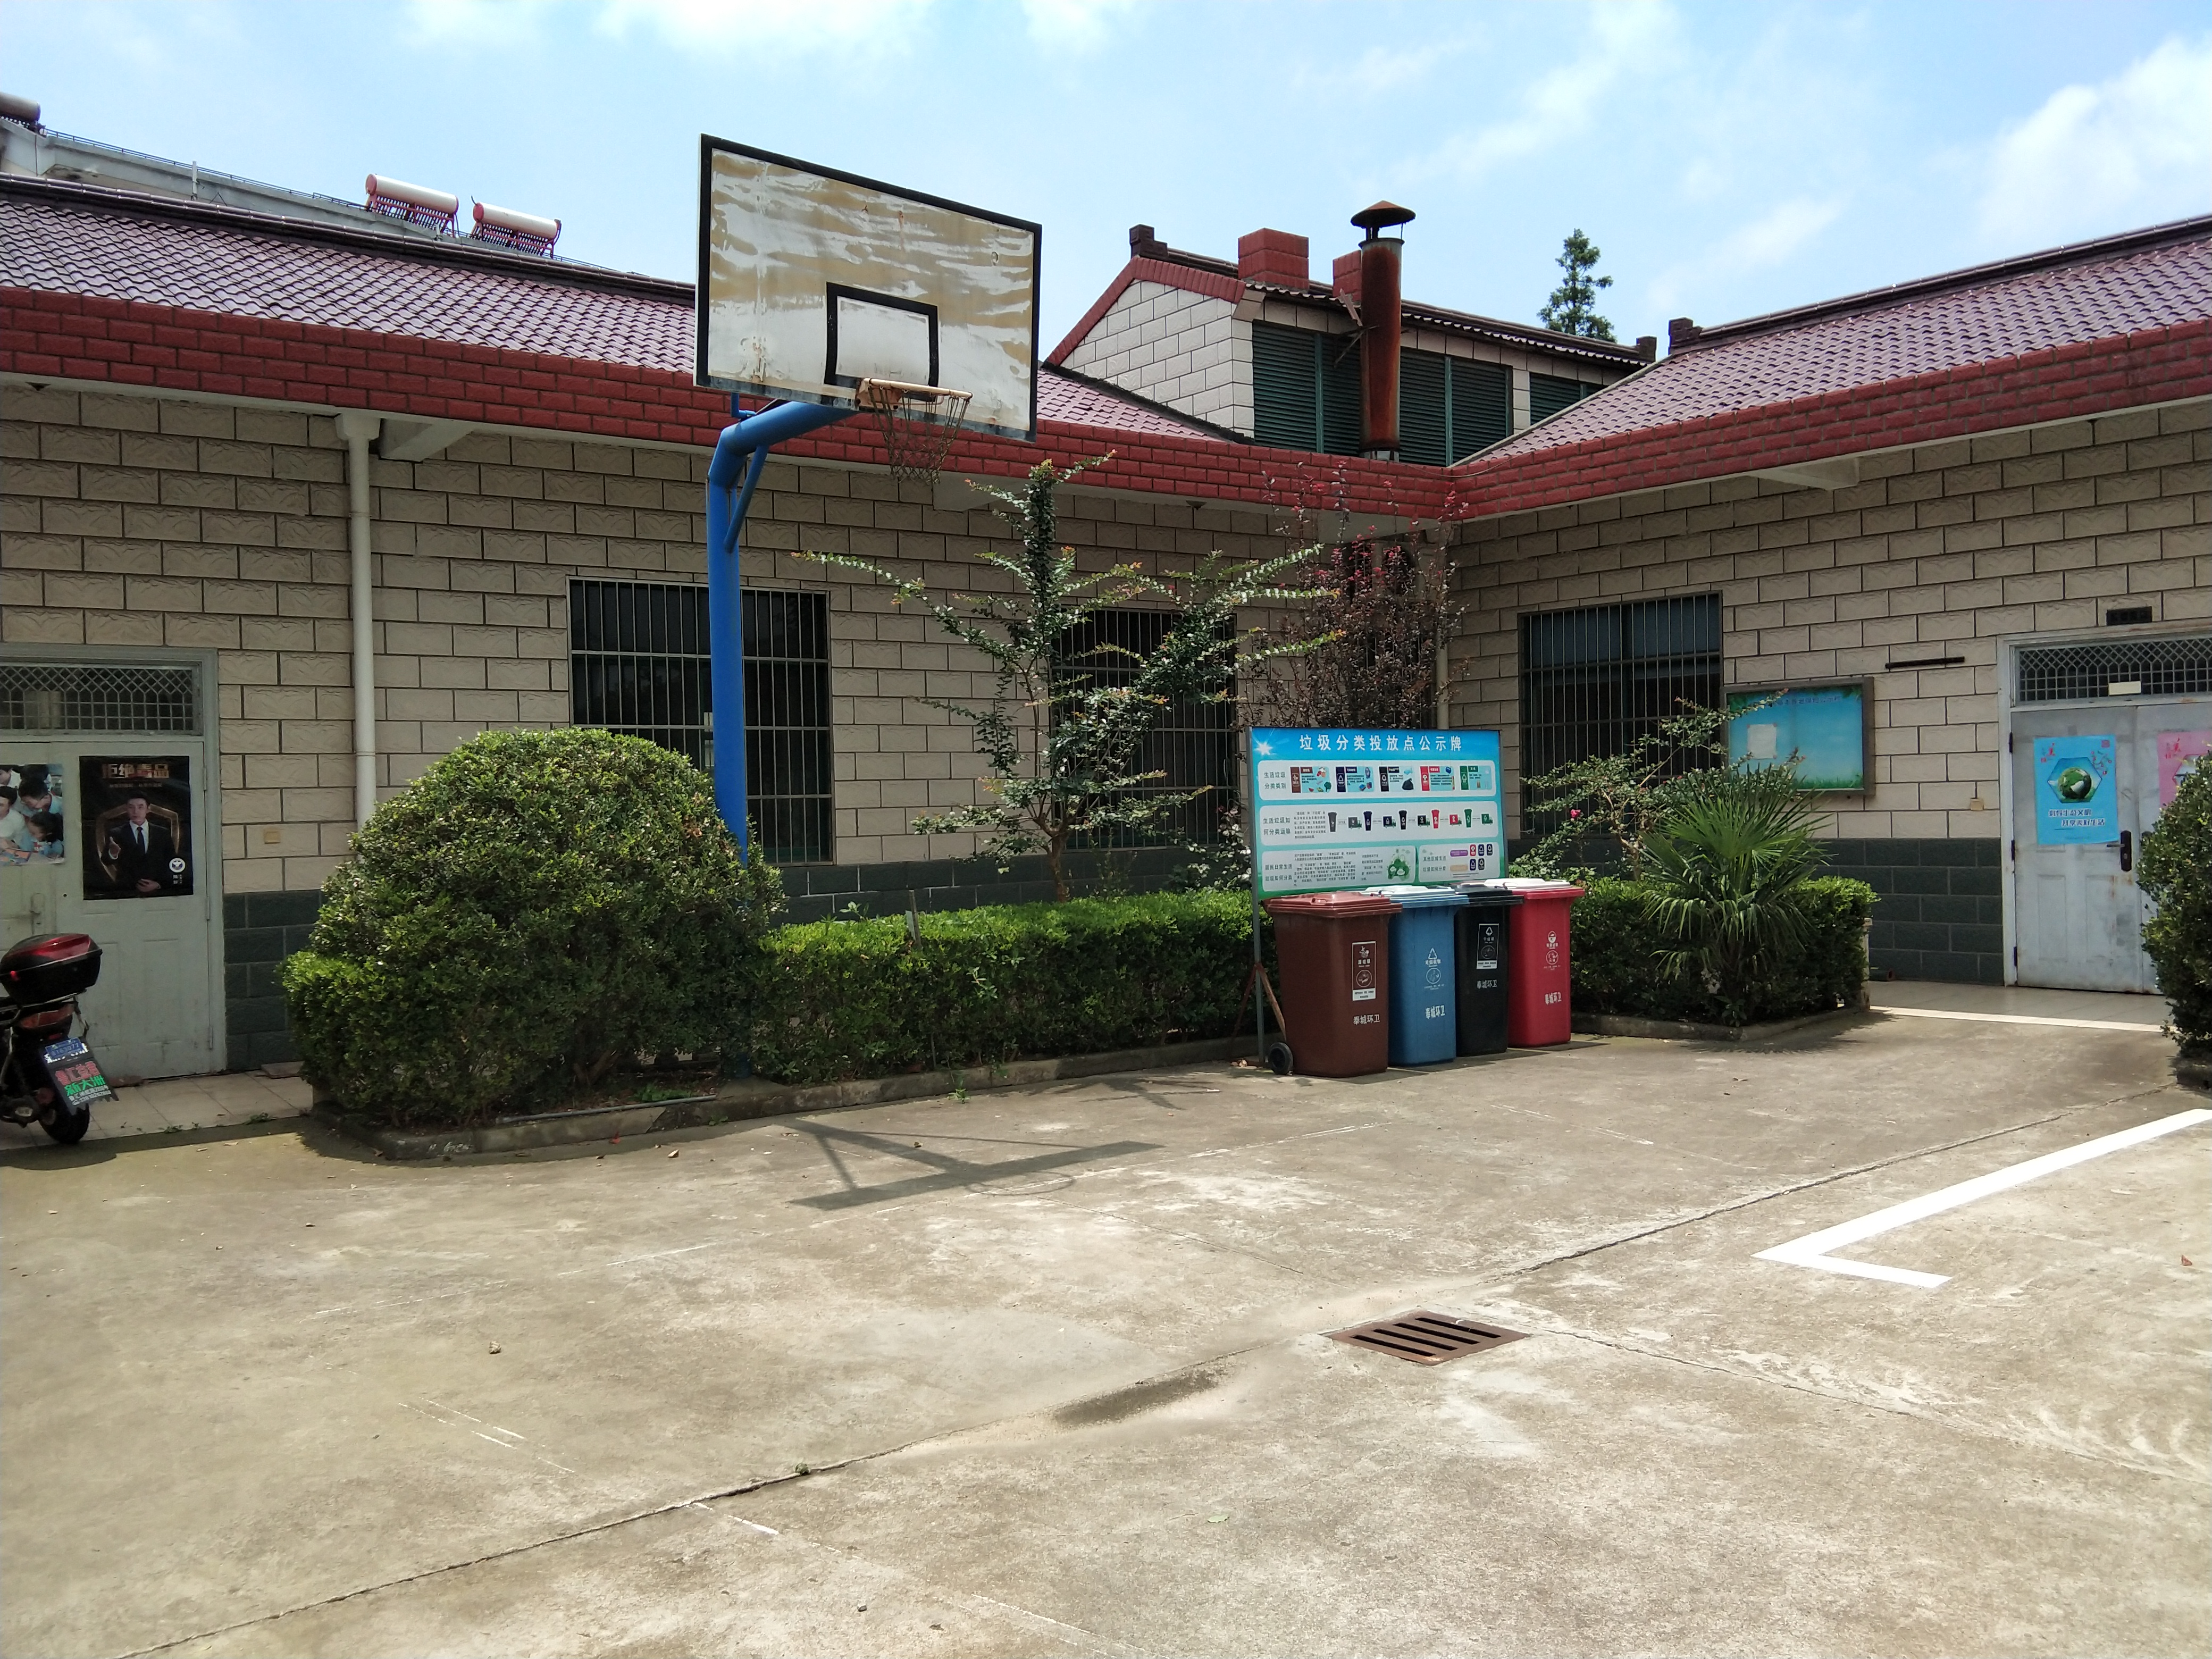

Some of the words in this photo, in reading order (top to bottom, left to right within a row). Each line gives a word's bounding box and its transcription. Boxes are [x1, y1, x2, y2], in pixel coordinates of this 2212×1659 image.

[1299, 734, 1462, 751] 垃圾分类投放点公示牌
[1477, 979, 1497, 989] 奉城环卫
[1545, 992, 1562, 1005] 奉城环卫
[1425, 1005, 1446, 1019] 奉城环卫
[1353, 1014, 1380, 1026] 奉城环卫
[64, 1075, 105, 1096] 新大洲
